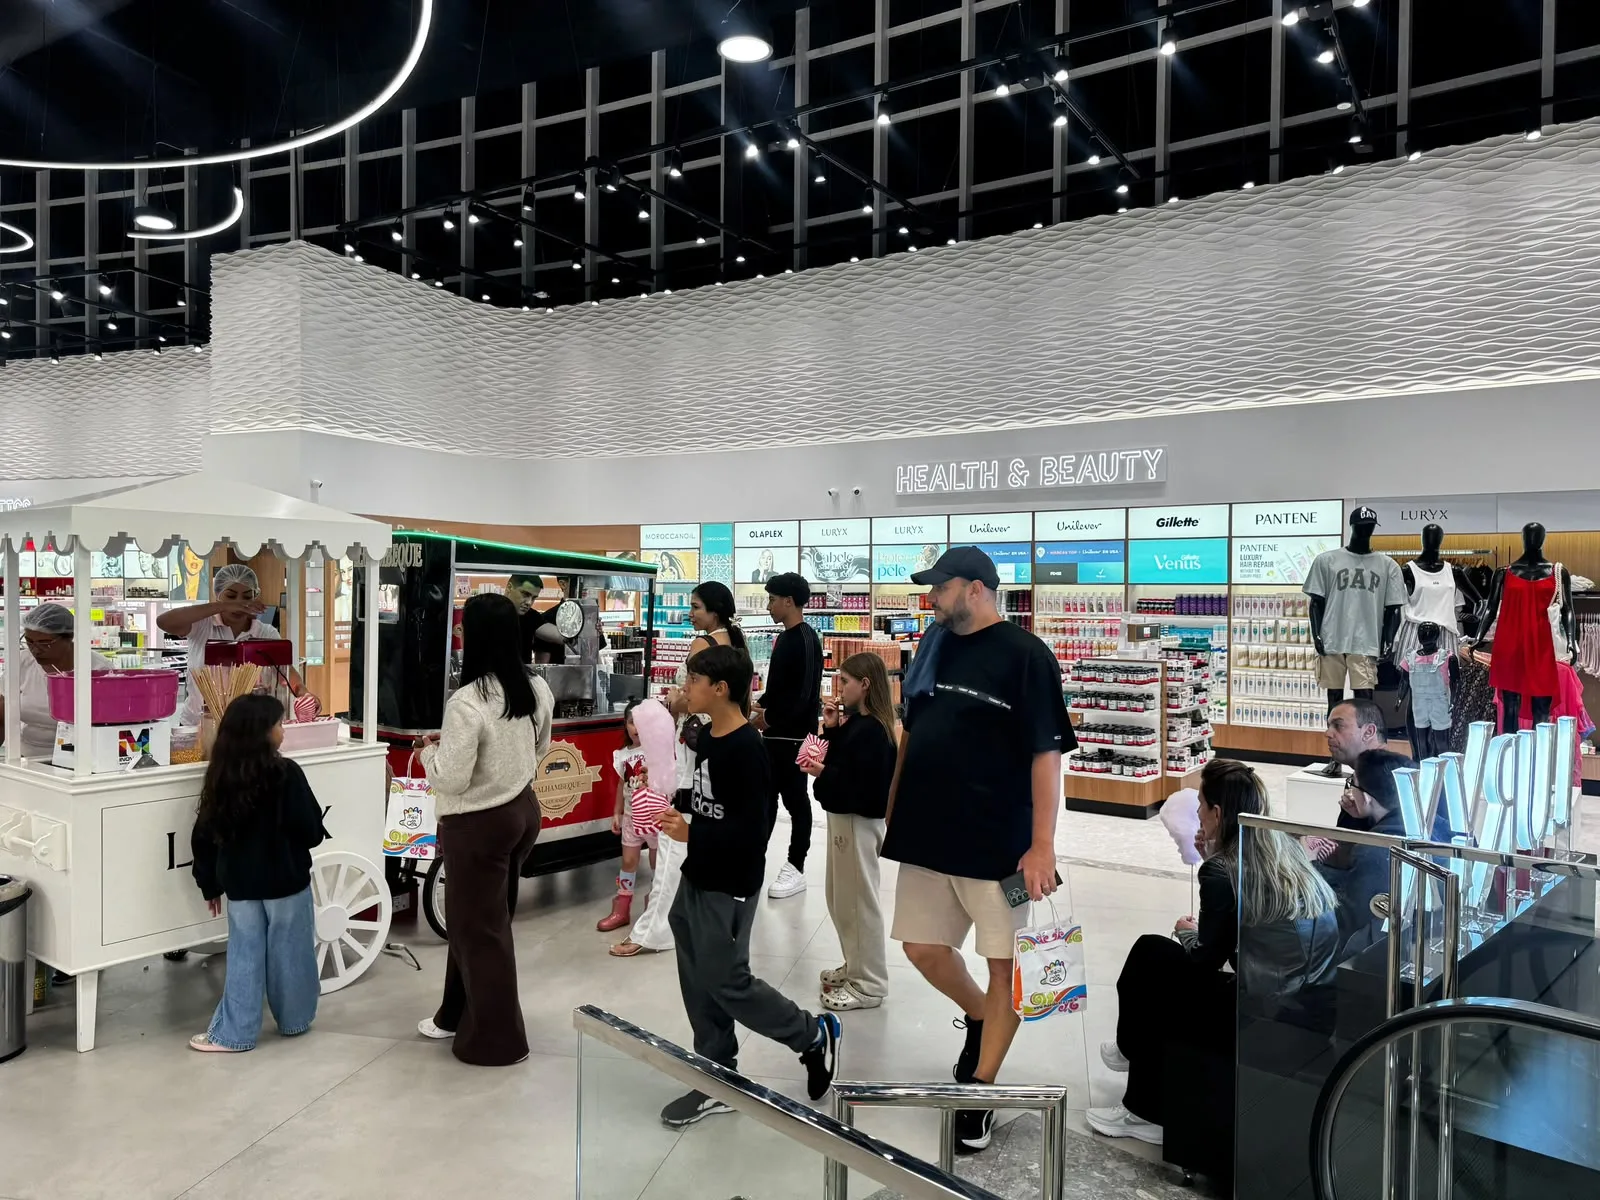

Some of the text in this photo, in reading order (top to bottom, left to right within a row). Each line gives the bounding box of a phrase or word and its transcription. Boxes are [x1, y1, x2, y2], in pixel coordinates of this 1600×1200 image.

[896, 448, 1164, 493] HEALTH & BEAUTY
[1255, 511, 1318, 525] PANTENE
[1400, 508, 1449, 521] LURYX
[1057, 520, 1101, 532] Unilever
[1155, 516, 1200, 528] Gillette
[749, 530, 783, 539] OLAPLEX
[821, 528, 848, 537] LURYX
[894, 526, 924, 535] LURYX
[969, 523, 1010, 534] Unilever
[645, 533, 696, 541] MOROCCANOIL
[1240, 544, 1278, 552] PANTENE
[1154, 554, 1201, 571] Venus
[878, 564, 906, 580] pele
[1336, 567, 1381, 594] GAP
